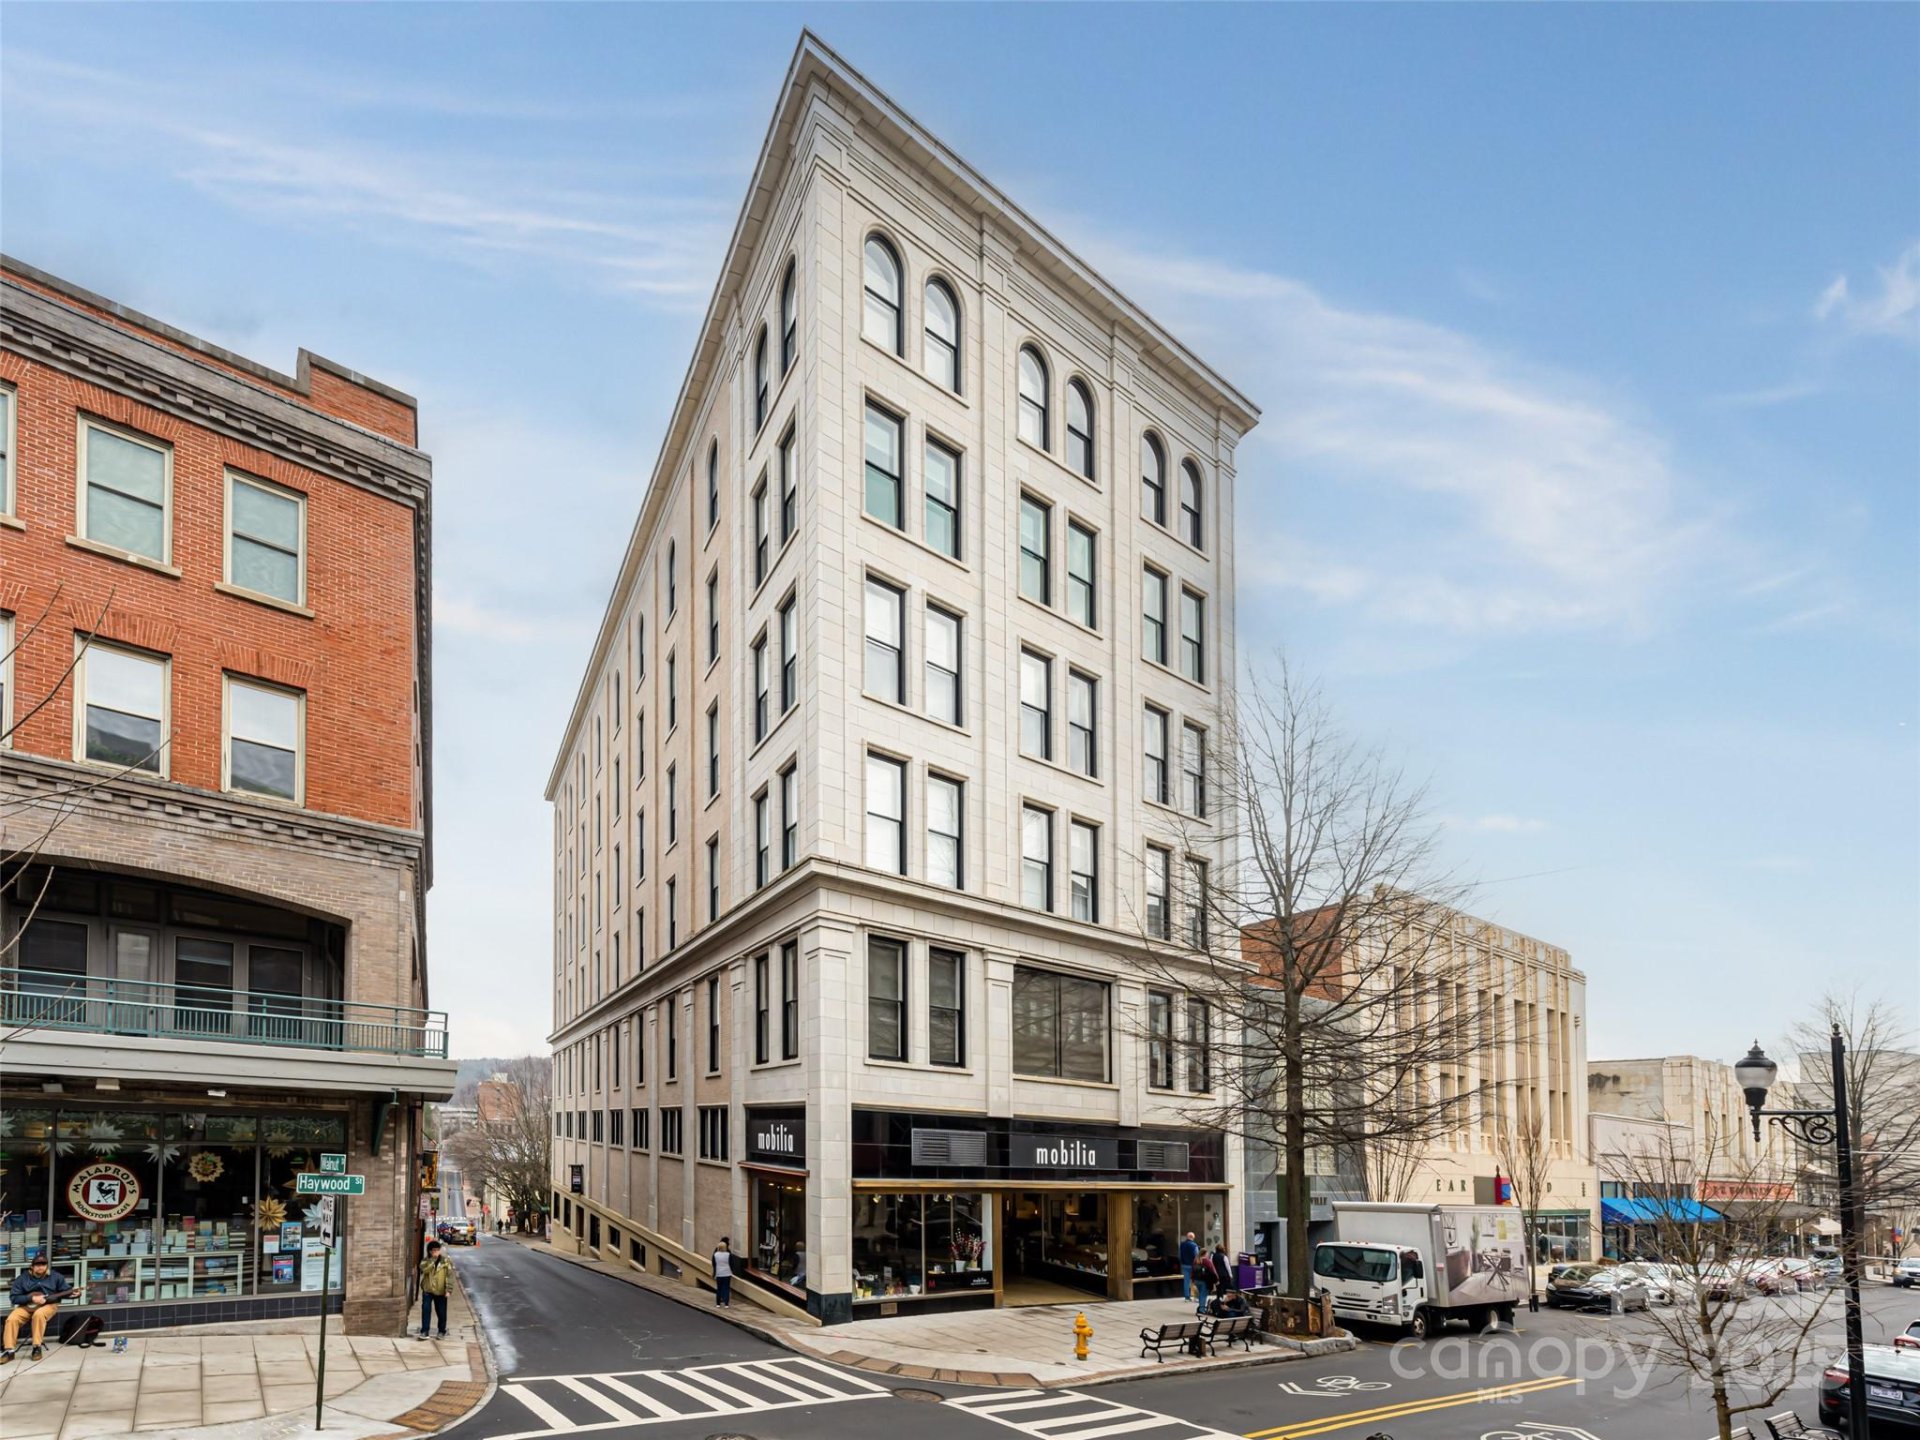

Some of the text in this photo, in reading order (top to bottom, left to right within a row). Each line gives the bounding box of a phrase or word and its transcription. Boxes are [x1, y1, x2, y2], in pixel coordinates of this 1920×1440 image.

[757, 1123, 794, 1153] mobilia
[1036, 1139, 1096, 1166] mobilia
[72, 1165, 137, 1195] MALAPROP'S
[299, 1175, 363, 1192] Haywood St
[75, 1200, 113, 1219] BOOKSTORE
